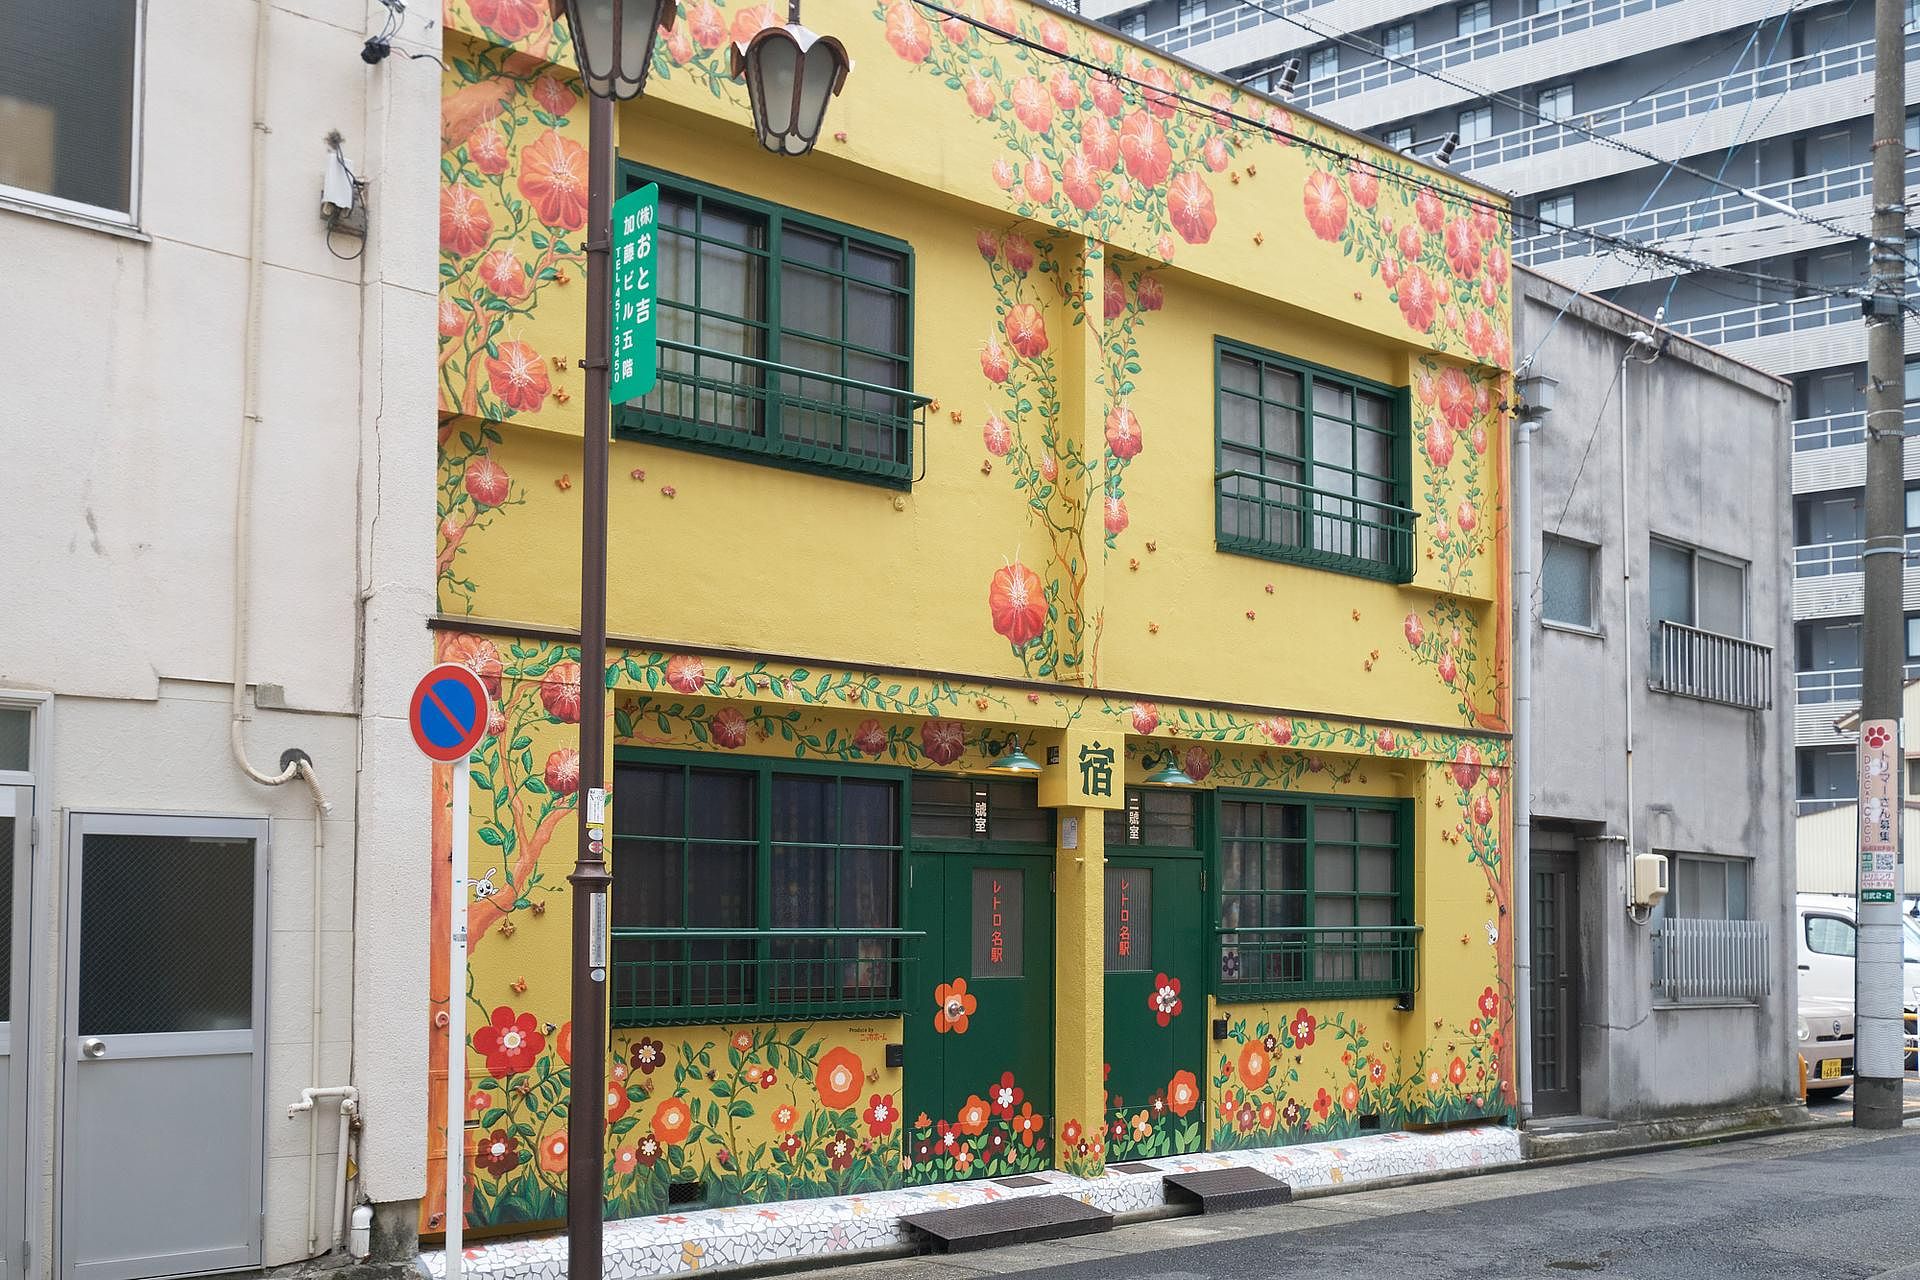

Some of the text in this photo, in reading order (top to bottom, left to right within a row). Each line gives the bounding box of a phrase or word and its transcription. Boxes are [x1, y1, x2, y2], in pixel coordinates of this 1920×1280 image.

[622, 213, 635, 381] 加藤ビル五階
[1078, 740, 1115, 797] 宿
[975, 791, 986, 833] 一號室
[1129, 798, 1140, 840] 二號室
[991, 880, 1003, 963] レトロ名駅
[1119, 879, 1131, 956] レトロ名駅
